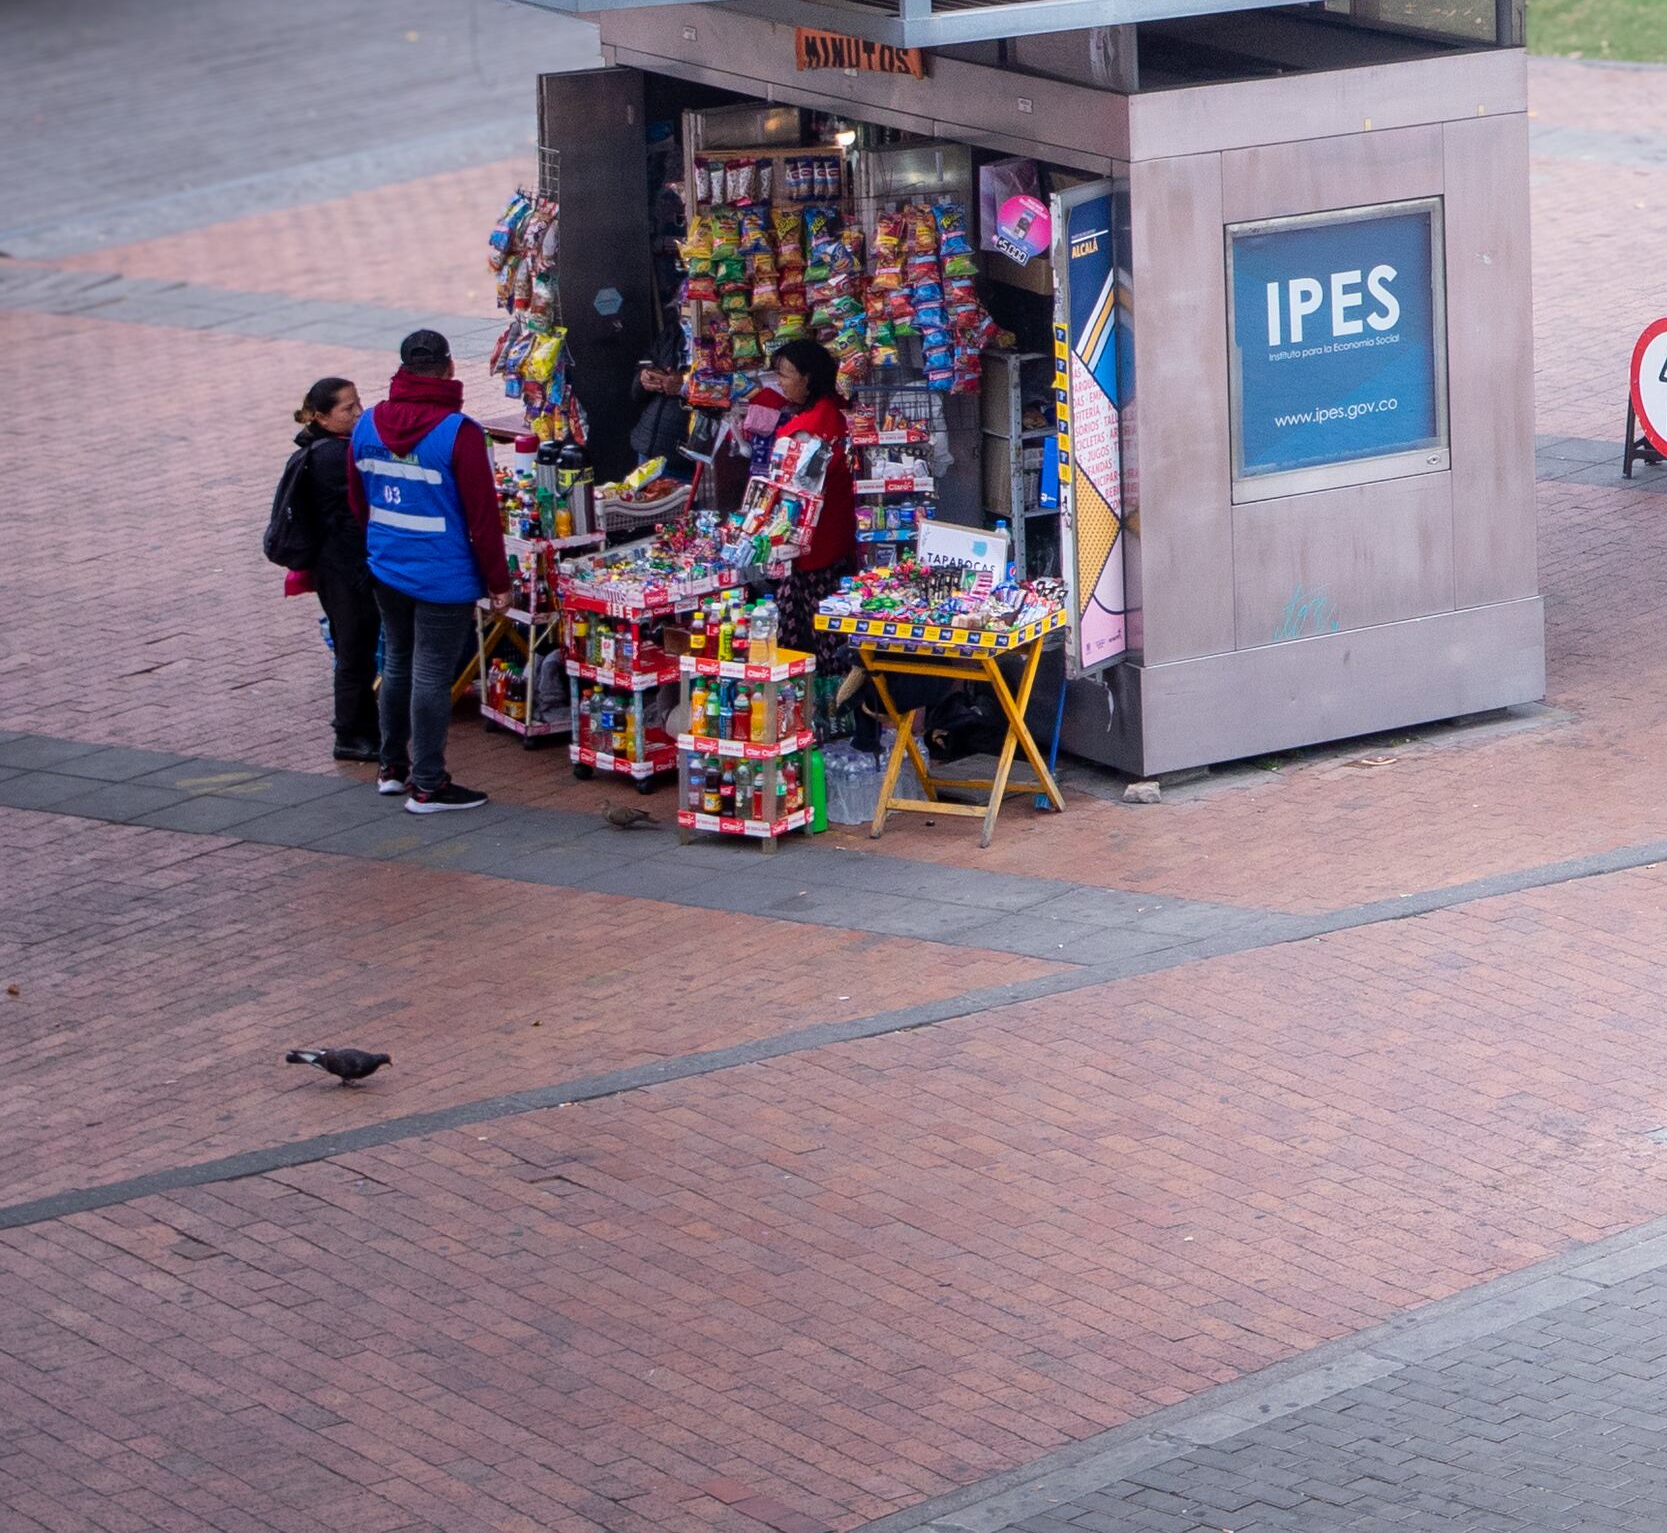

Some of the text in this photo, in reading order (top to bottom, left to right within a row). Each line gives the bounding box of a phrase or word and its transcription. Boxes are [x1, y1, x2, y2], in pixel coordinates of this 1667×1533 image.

[804, 35, 913, 74] MINUTOS
[1071, 236, 1099, 260] ALCALÁ
[1266, 264, 1401, 347] IPES
[1269, 350, 1301, 362] Instituto
[1302, 347, 1323, 359] para
[1323, 344, 1333, 354] la
[1375, 333, 1400, 346] Social
[1274, 397, 1399, 428] www.ipes.gov.co
[384, 484, 402, 505] 03
